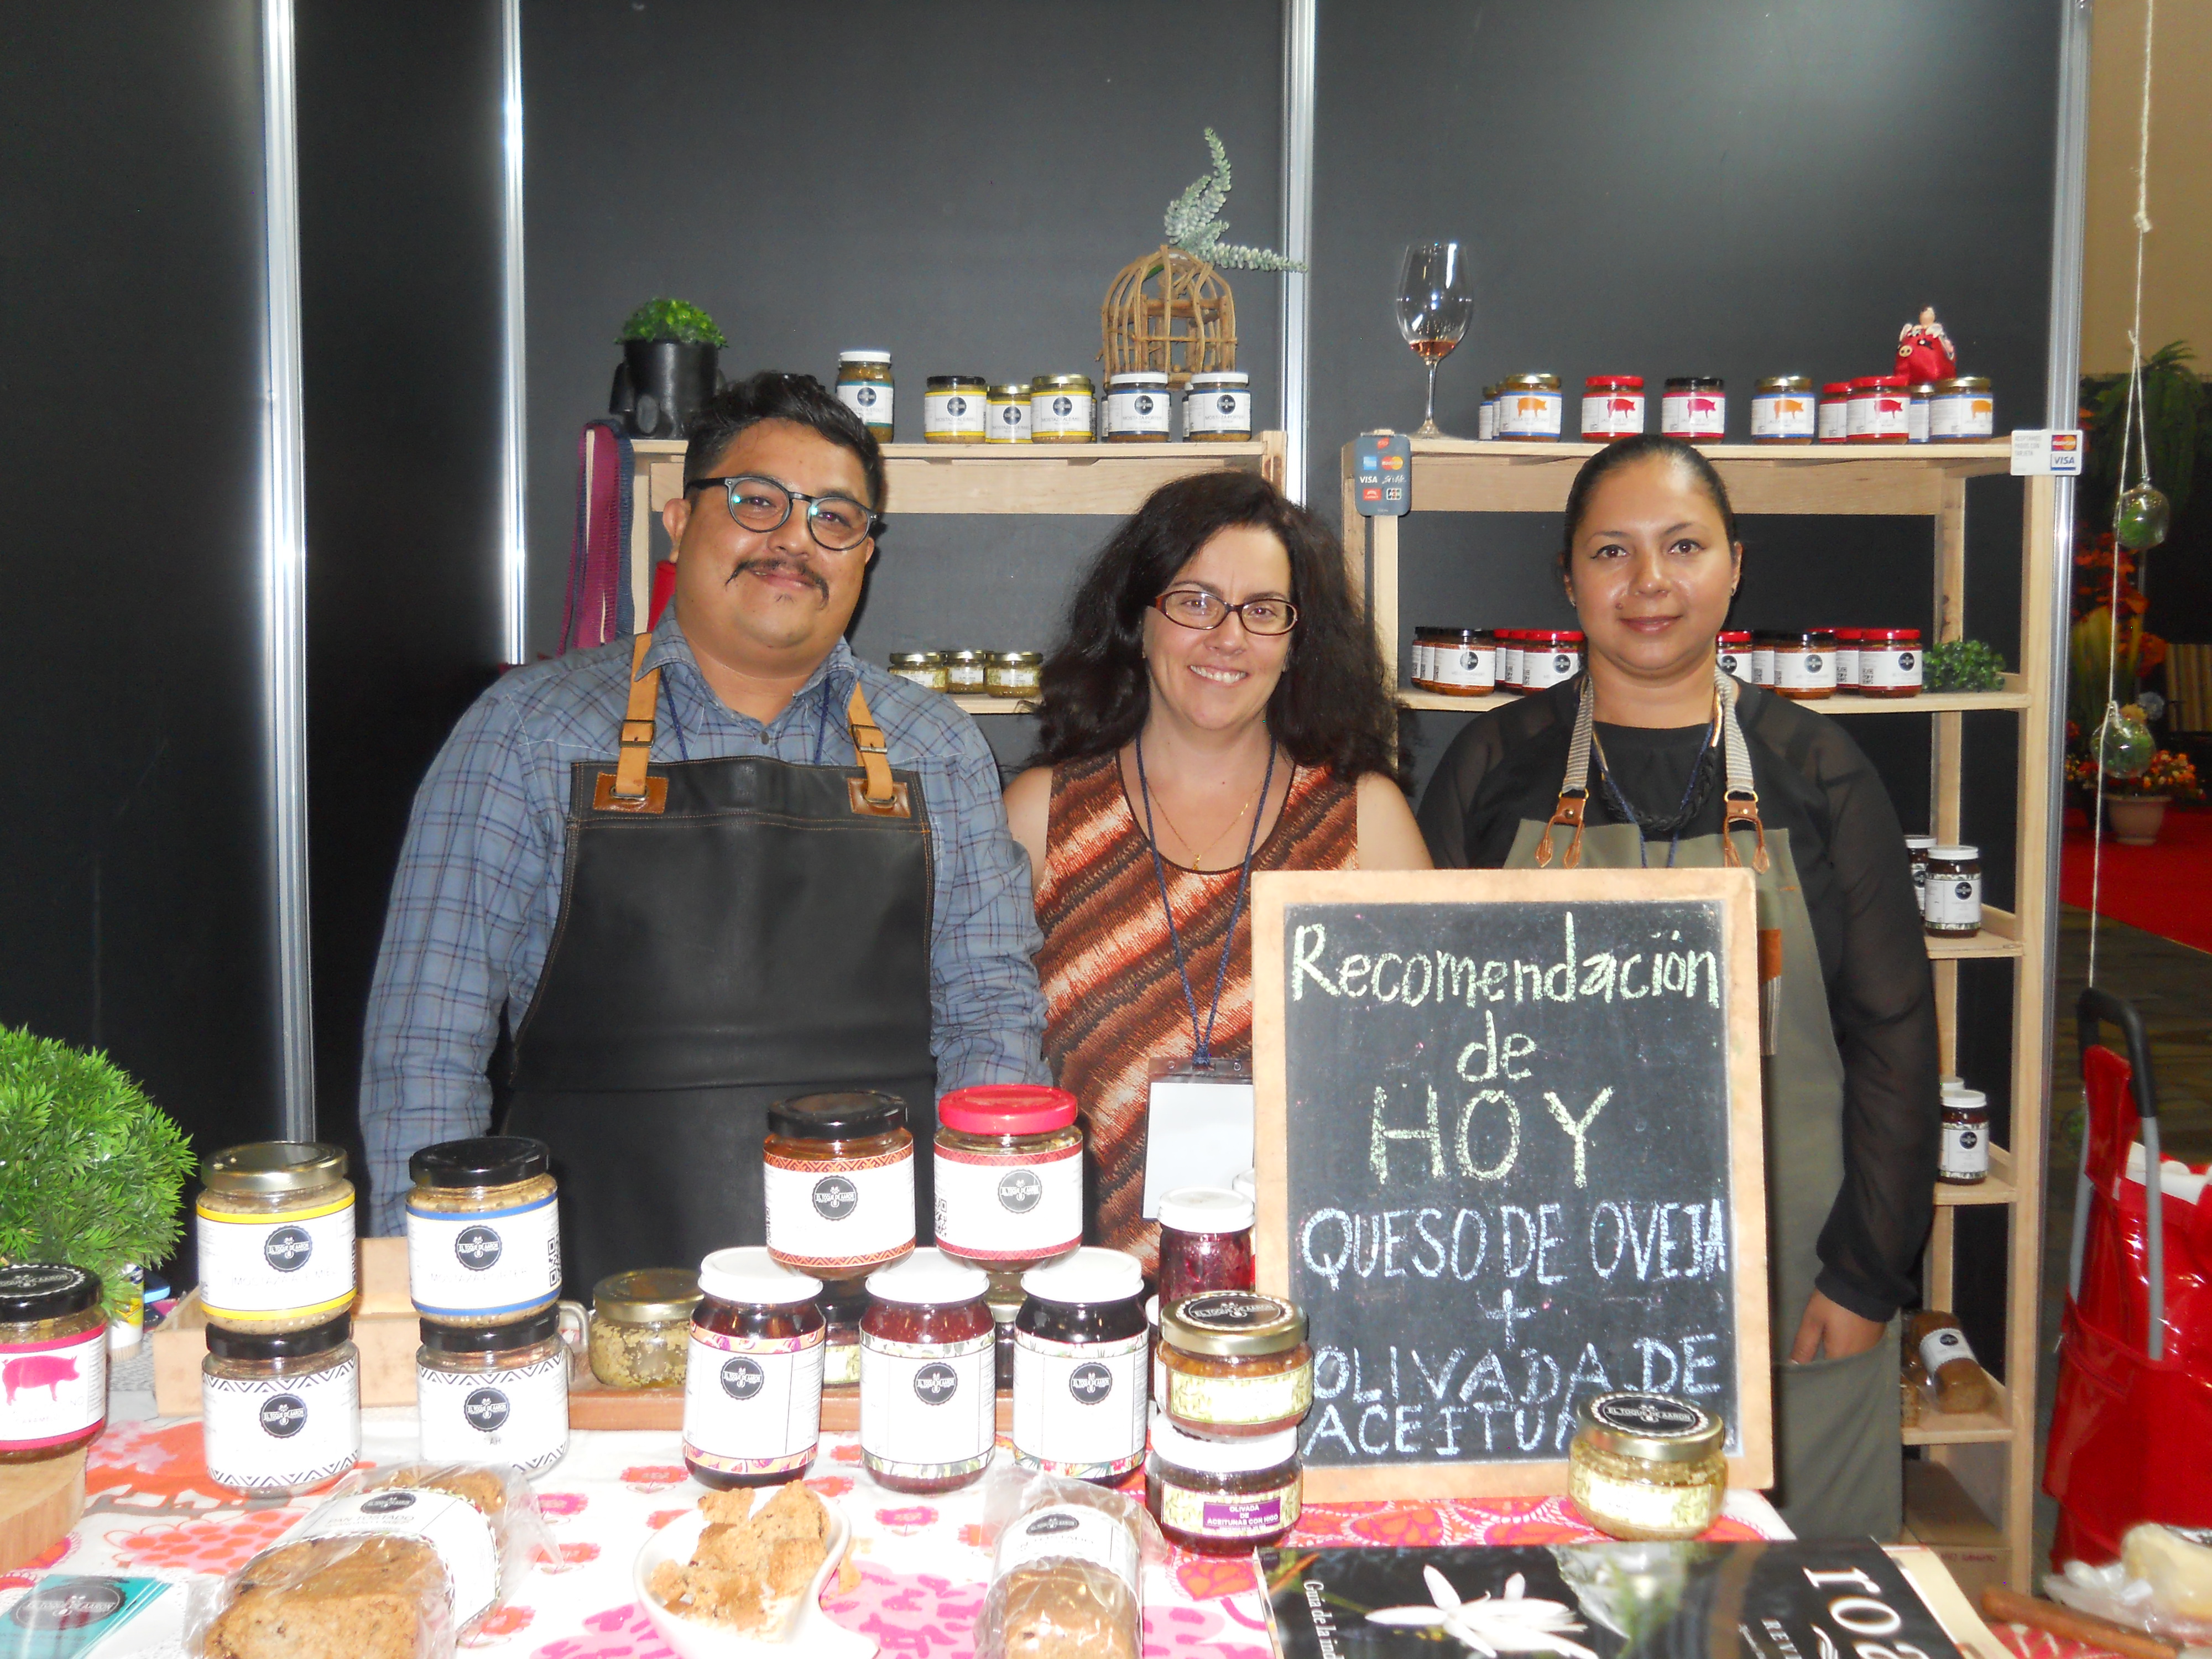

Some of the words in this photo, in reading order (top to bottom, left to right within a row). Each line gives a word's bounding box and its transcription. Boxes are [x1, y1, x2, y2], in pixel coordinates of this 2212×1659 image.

[1292, 911, 1720, 1009] Recomendación
[1457, 1010, 1537, 1083] de
[1369, 1085, 1614, 1190] HOY
[1302, 1207, 1487, 1291] QUESO
[1501, 1203, 1567, 1285] DE
[1590, 1198, 1726, 1281] OVEJA
[1313, 1342, 1612, 1416] OLIVADA
[1625, 1333, 1721, 1395] DE
[1662, 1412, 1691, 1421] AARON
[1207, 1517, 1248, 1526] ACEITUNAS
[1264, 1514, 1279, 1522] HIGO
[1229, 1504, 1260, 1512] OLIVADA
[1303, 1579, 1326, 1608] Guía
[1311, 1609, 1333, 1624] de
[1316, 1625, 1337, 1637] la
